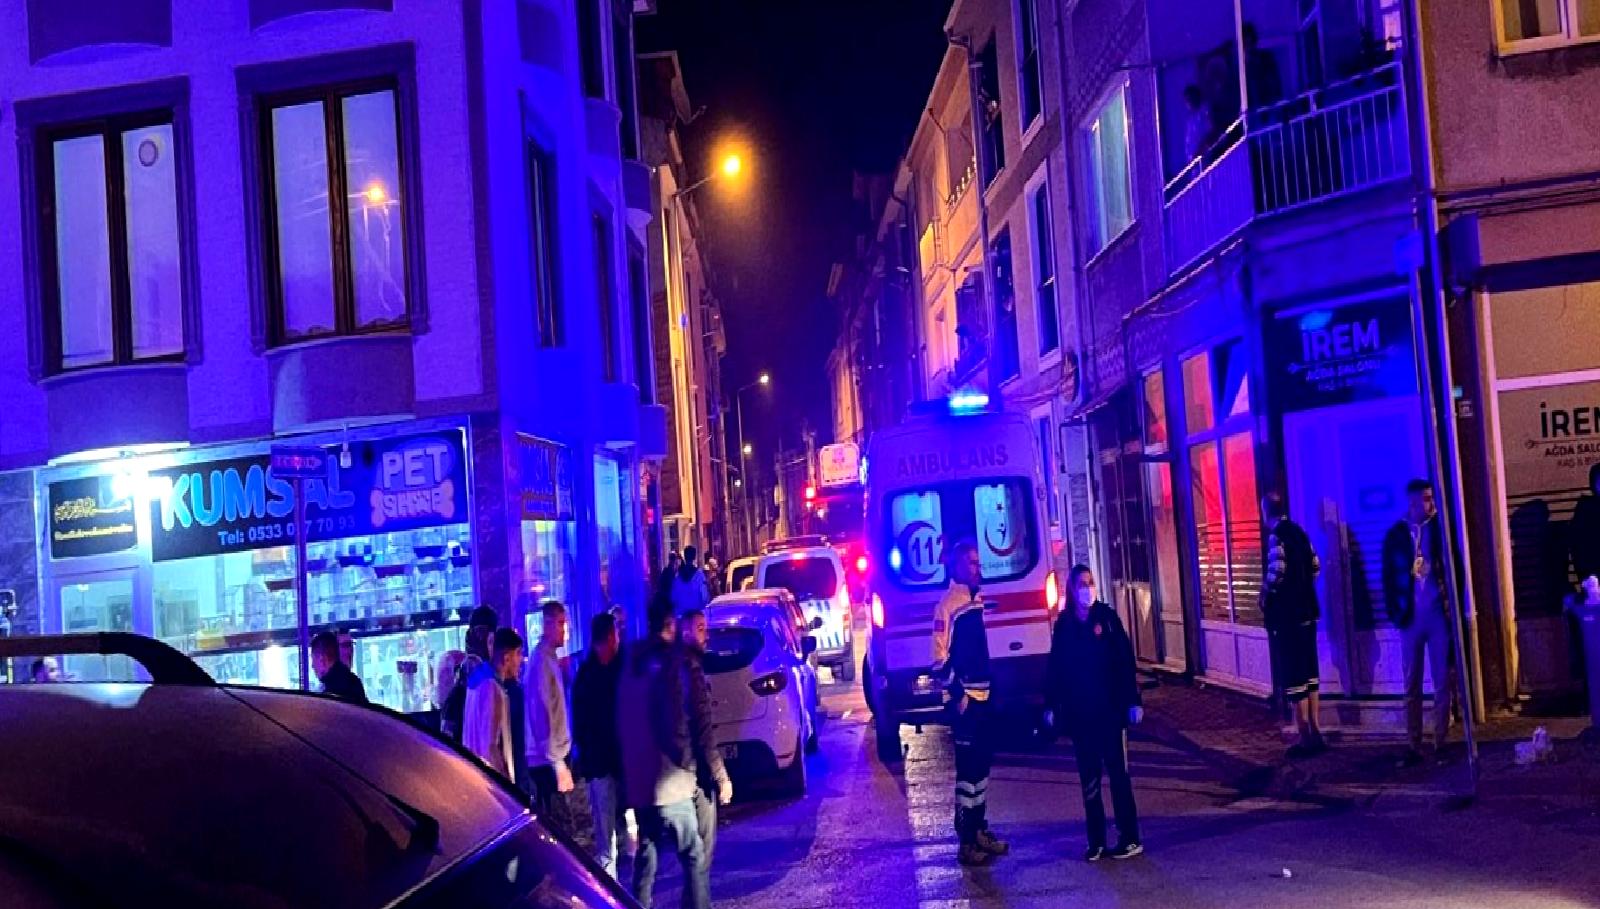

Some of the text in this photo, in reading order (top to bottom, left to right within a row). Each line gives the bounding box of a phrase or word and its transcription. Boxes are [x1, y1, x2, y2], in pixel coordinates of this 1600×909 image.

[1301, 319, 1380, 361] İREM
[1540, 402, 1600, 438] İRE
[383, 445, 447, 488] PET
[897, 443, 1008, 476] AMBULANS
[157, 455, 355, 531] KUMSAL
[217, 529, 245, 545] Tel:
[248, 523, 282, 541] 0533
[286, 520, 312, 537] 07
[317, 517, 333, 532] 70
